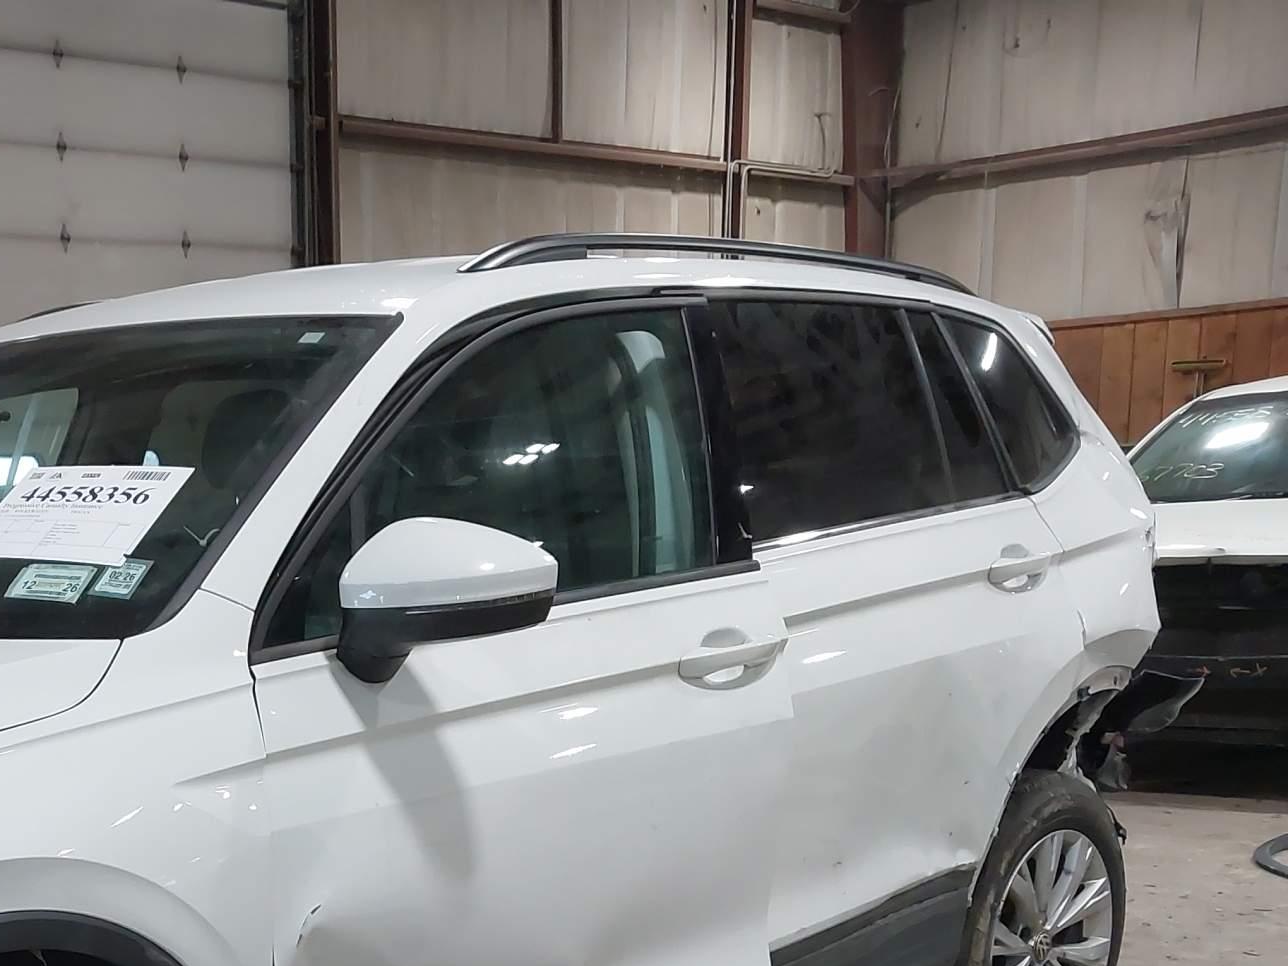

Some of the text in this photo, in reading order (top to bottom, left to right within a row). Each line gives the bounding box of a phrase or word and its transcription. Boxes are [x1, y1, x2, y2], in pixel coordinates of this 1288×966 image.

[20, 486, 158, 505] 44558356
[109, 570, 136, 581] 02 26
[21, 580, 80, 593] 12 26
